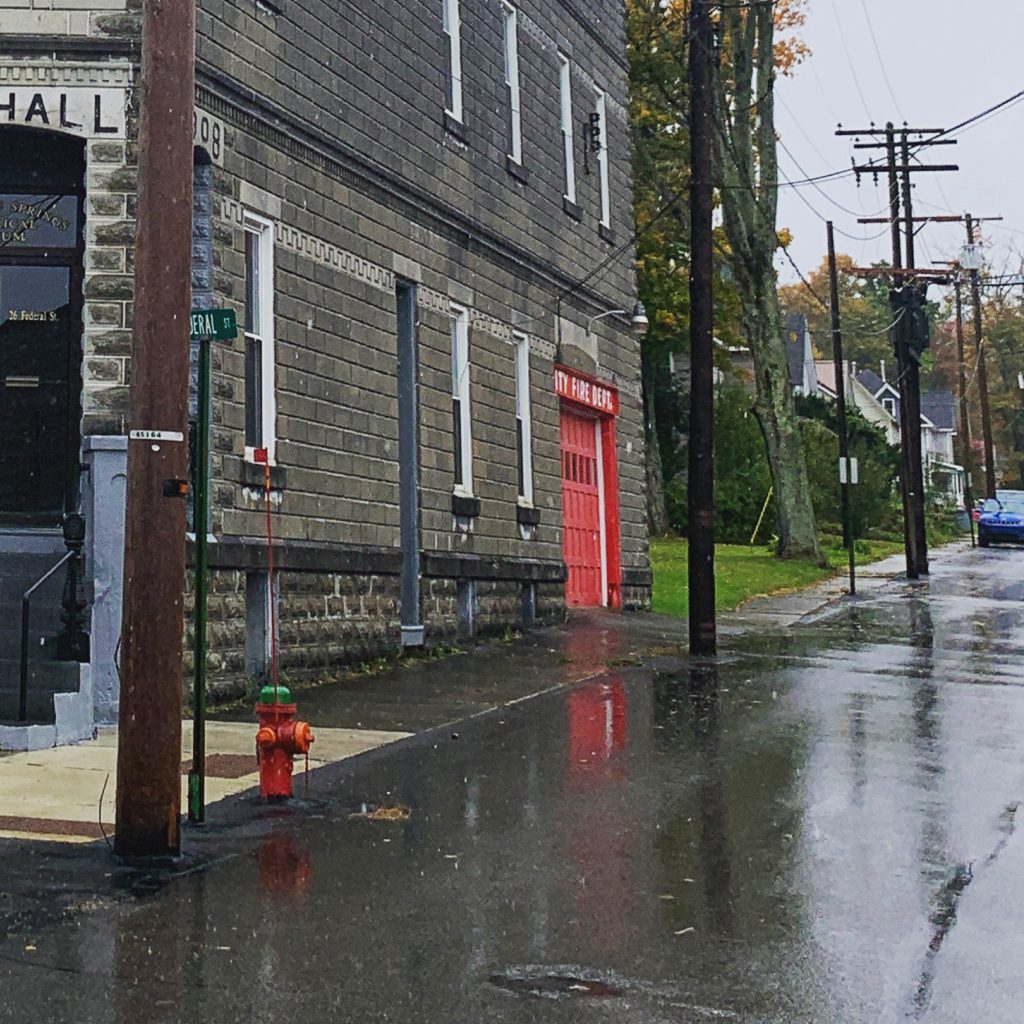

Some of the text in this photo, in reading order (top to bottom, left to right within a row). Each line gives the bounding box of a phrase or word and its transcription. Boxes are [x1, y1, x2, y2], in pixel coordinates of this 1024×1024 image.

[192, 110, 220, 160] 08
[10, 201, 70, 231] SPRINGS
[8, 309, 18, 321] 26
[20, 309, 47, 321] Federal
[223, 317, 231, 329] ST
[554, 369, 569, 394] ITY
[571, 377, 591, 403] FIRE
